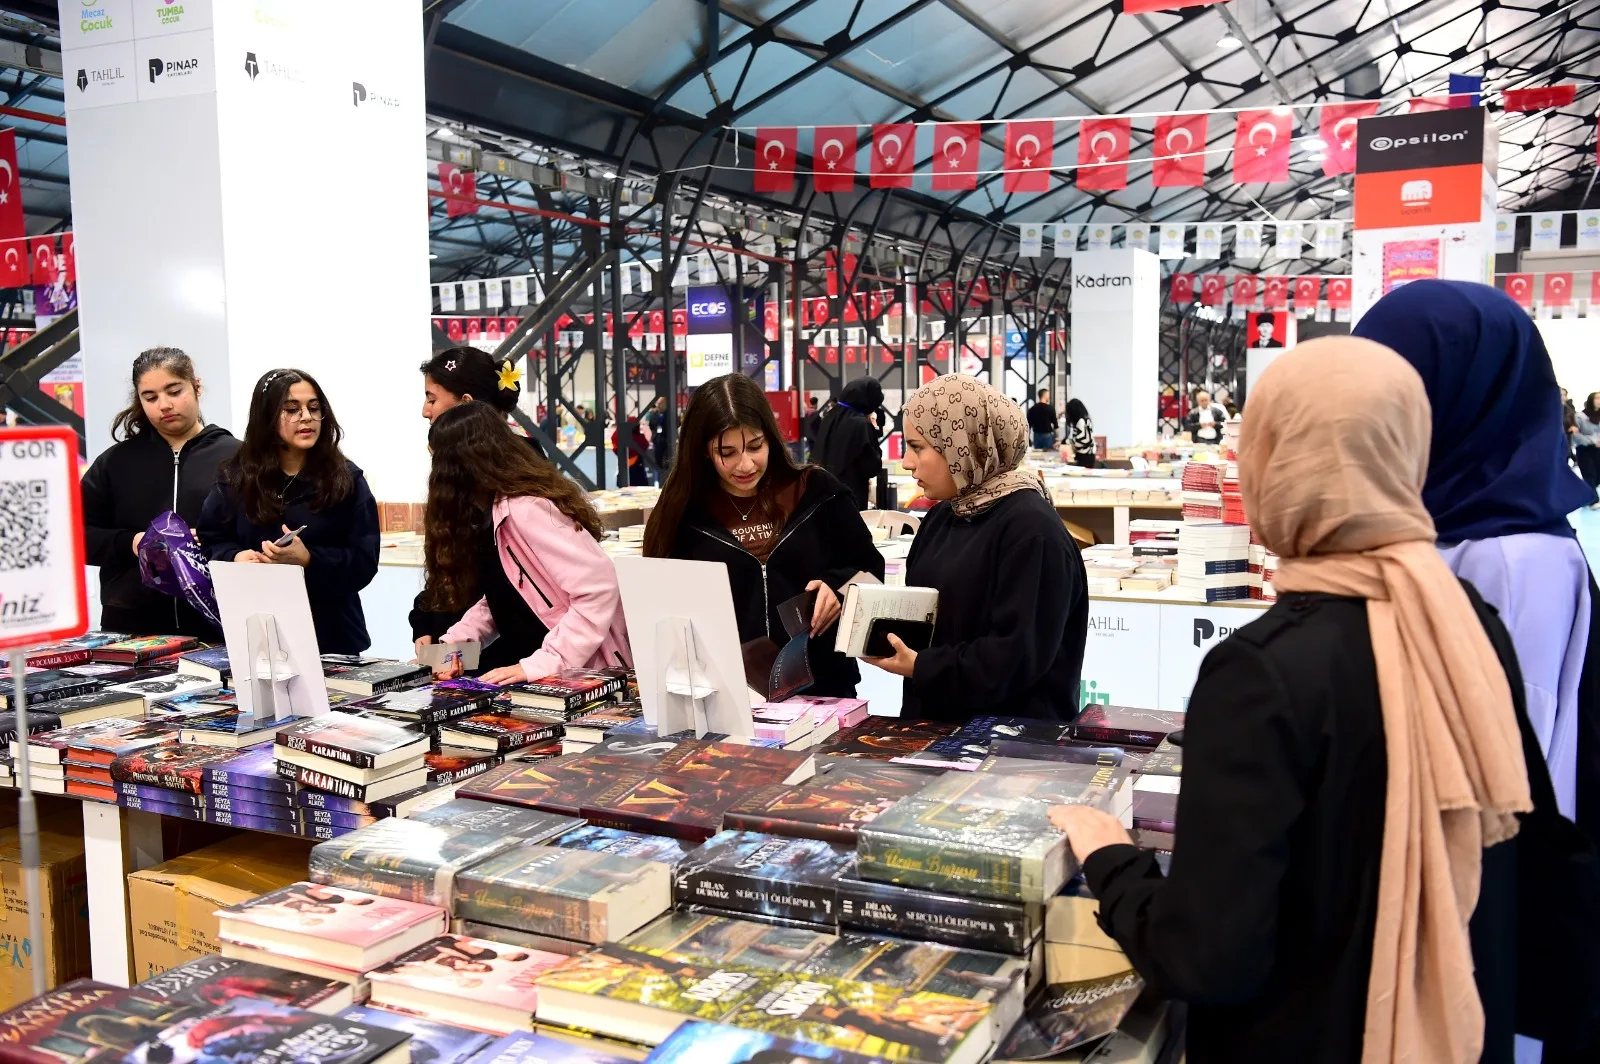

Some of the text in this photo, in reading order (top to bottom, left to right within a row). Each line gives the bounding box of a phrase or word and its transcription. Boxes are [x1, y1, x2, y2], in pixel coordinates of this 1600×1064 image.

[81, 8, 105, 19] Mecaz
[156, 5, 184, 18] TUMBA
[80, 18, 113, 34] Çocuk
[166, 58, 199, 73] PINAR
[91, 68, 125, 82] TAHLİL
[1076, 274, 1132, 289] Kadran
[692, 302, 726, 315] ECOS
[704, 353, 729, 361] DEFNE
[1088, 616, 1130, 631] AHLİL
[585, 680, 622, 702] KARANTİNA
[450, 702, 478, 716] KARANTİNA
[287, 735, 306, 745] BEYZA
[525, 728, 553, 743] KARANTİNA
[287, 741, 306, 752] ALKOÇ
[312, 744, 352, 762] KARANTİNA
[280, 767, 296, 778] ALKOÇ
[455, 762, 487, 779] KARANTİNA
[122, 782, 137, 791] BEYZA
[300, 768, 355, 798] KARANTİNA
[308, 793, 324, 802] BEYZA
[314, 810, 330, 818] BEYZA
[316, 826, 333, 834] BEYZA
[700, 880, 725, 890] DİLAN
[696, 888, 730, 900] DURMAZ
[865, 901, 892, 912] DİLAN
[860, 908, 898, 922] DURMAZ
